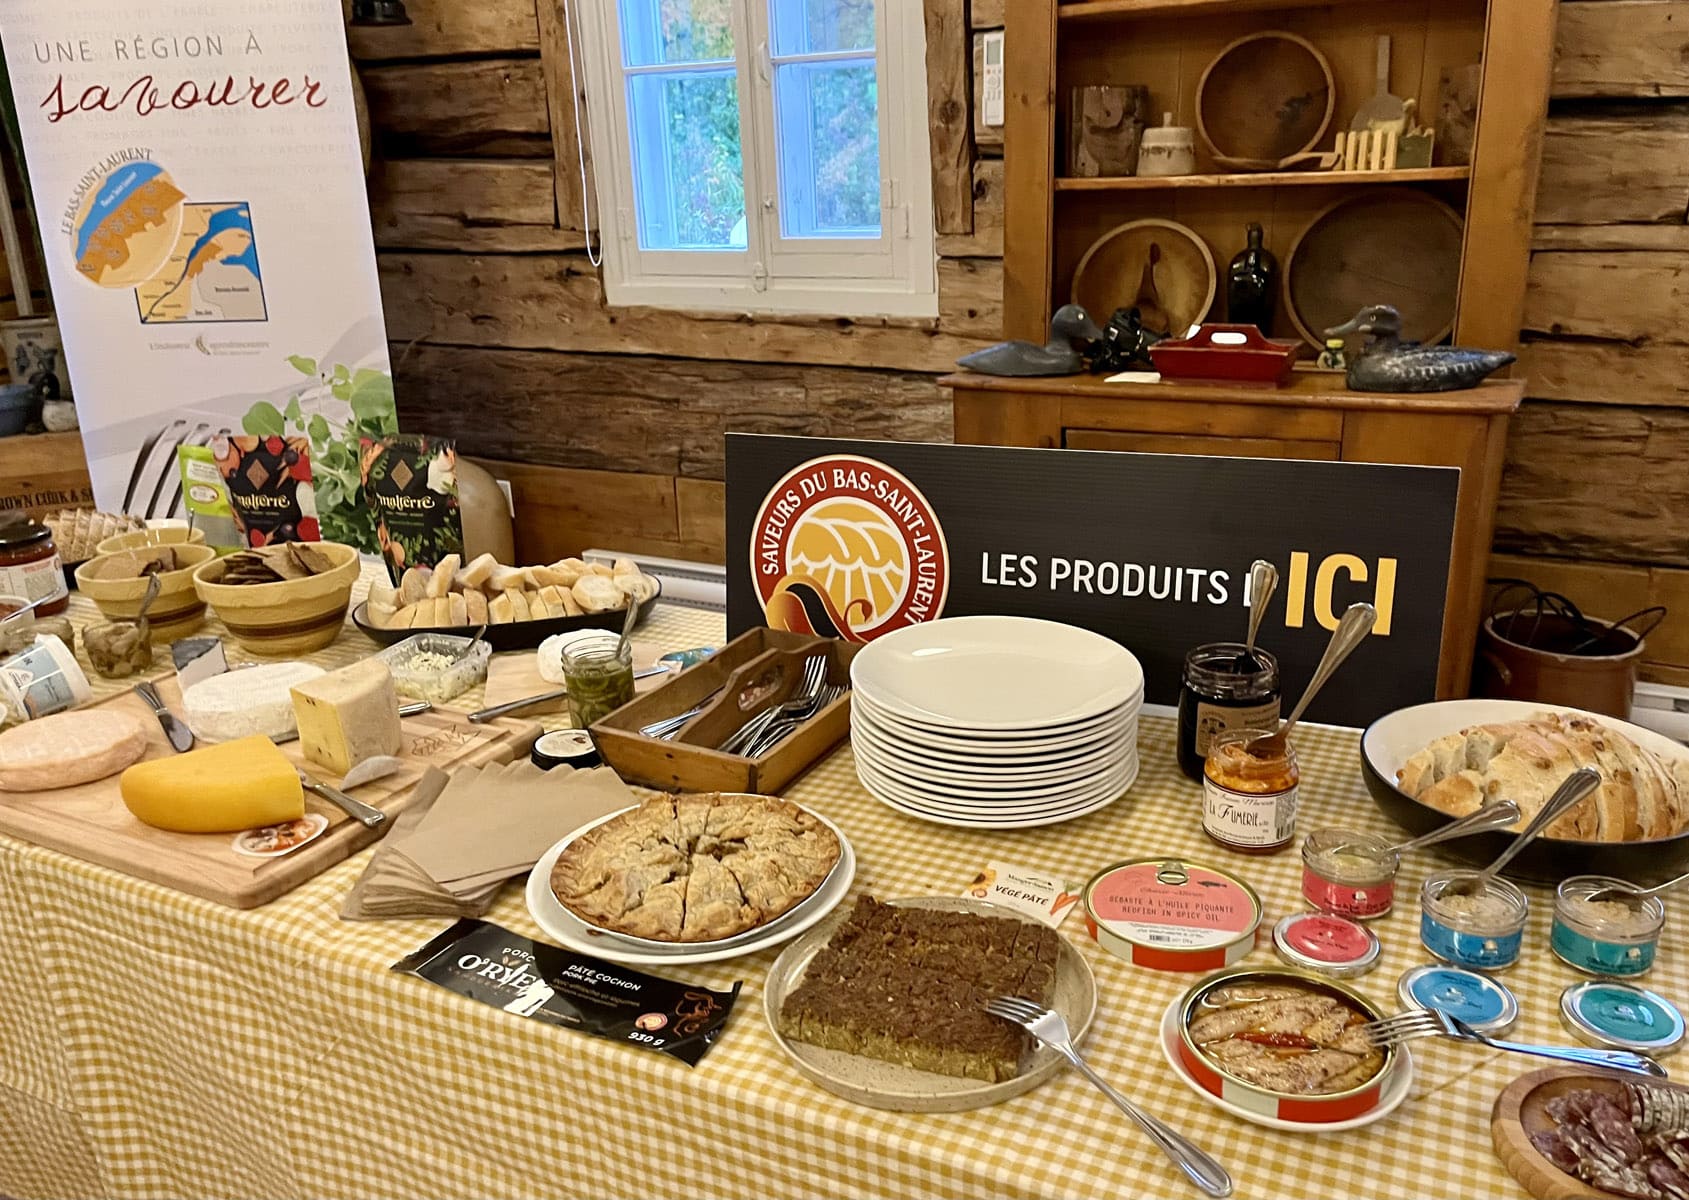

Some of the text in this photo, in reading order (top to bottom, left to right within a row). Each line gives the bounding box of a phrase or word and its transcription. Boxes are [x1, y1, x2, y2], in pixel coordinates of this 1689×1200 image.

[33, 39, 94, 64] UNE
[114, 34, 224, 61] RÉGION
[245, 28, 263, 55] À
[40, 74, 328, 123] savourer
[762, 489, 802, 576] SAVEURS
[799, 470, 828, 500] DU
[981, 551, 1039, 589] LES
[1049, 557, 1230, 608] PRODUITS
[1284, 551, 1398, 636] ICI
[502, 947, 536, 963] PORC
[562, 970, 583, 981] PORK
[595, 973, 642, 992] COCHON
[628, 1031, 665, 1046] 930 g
